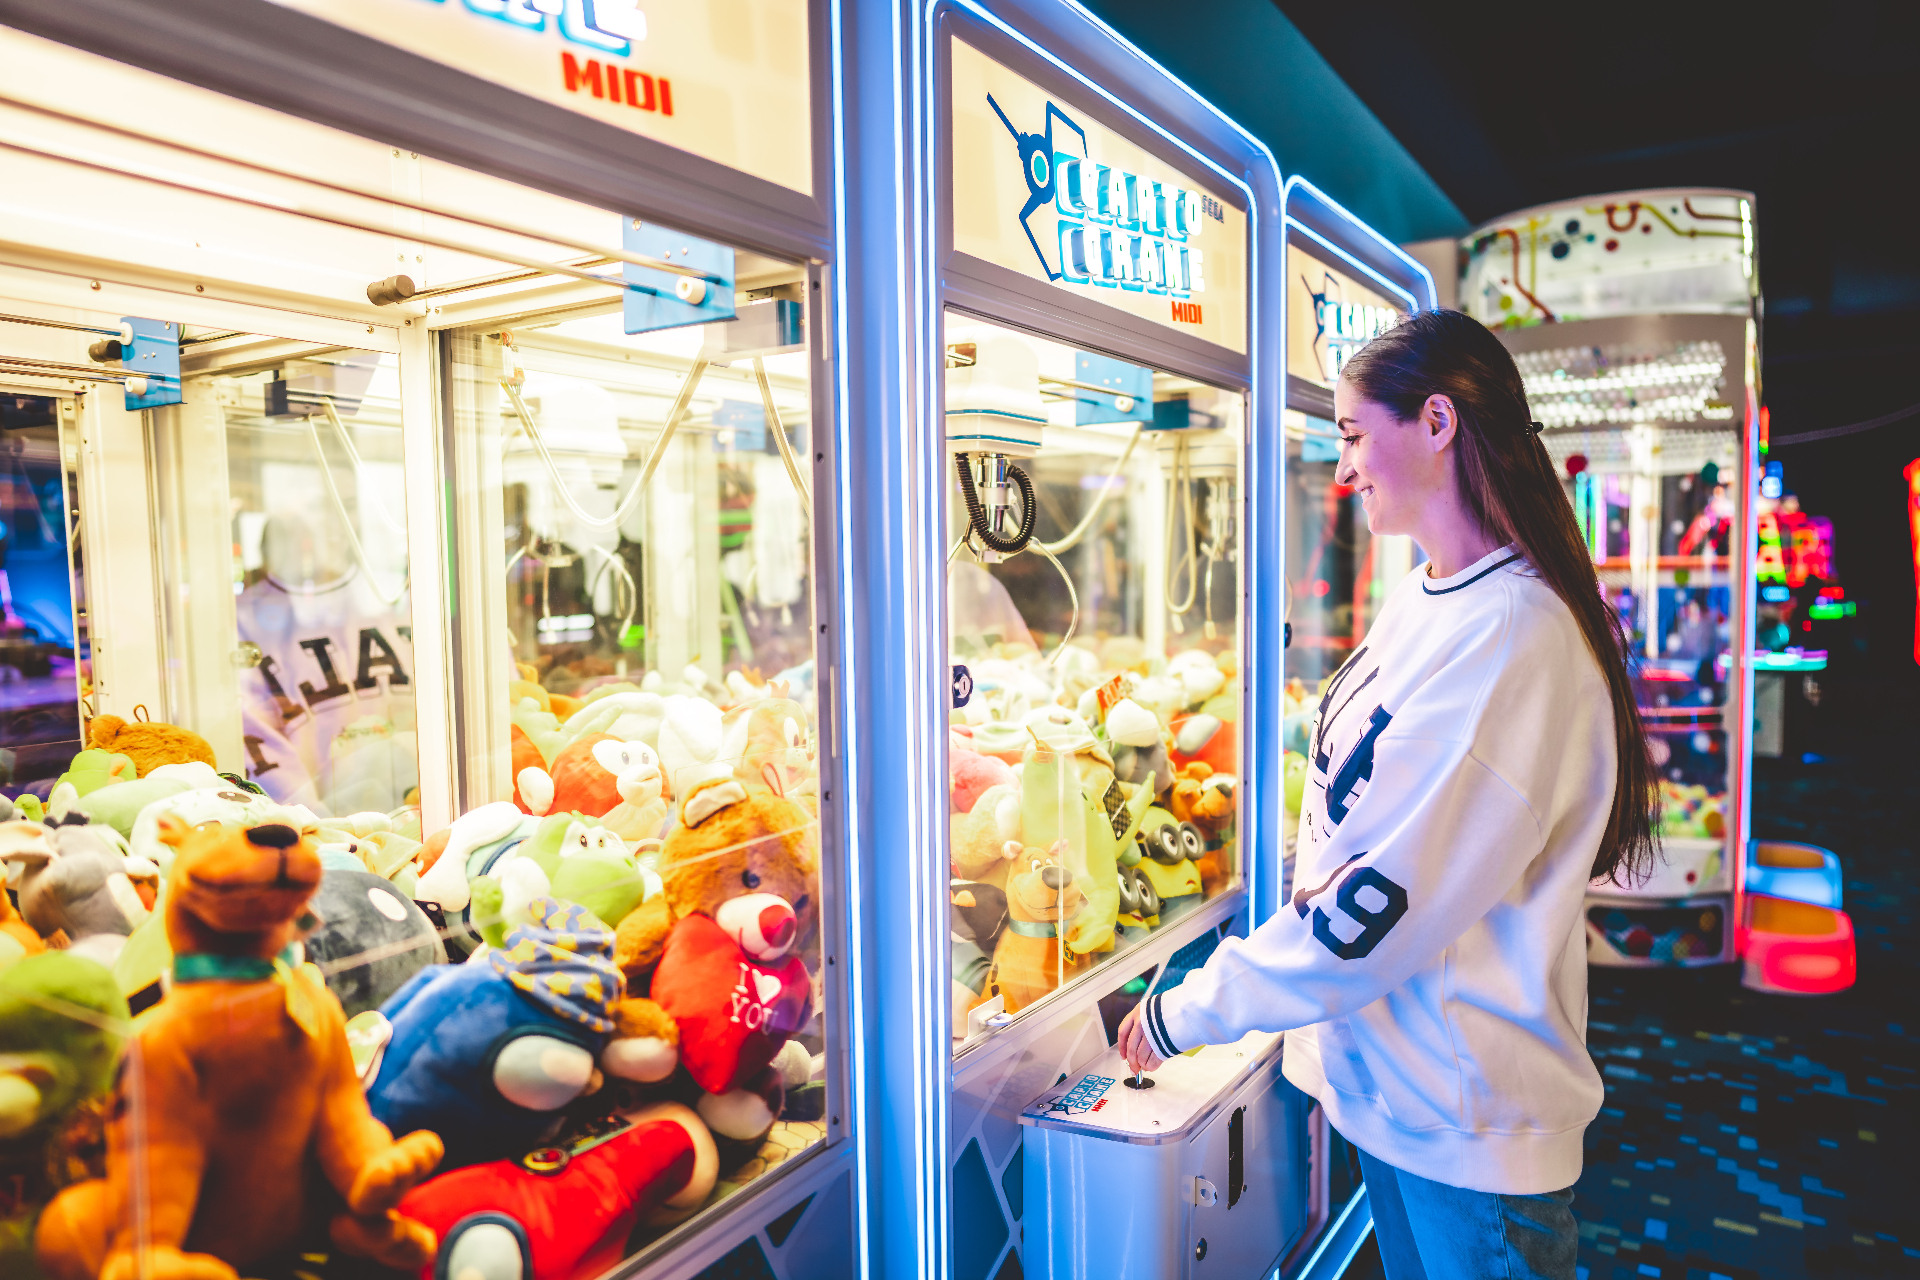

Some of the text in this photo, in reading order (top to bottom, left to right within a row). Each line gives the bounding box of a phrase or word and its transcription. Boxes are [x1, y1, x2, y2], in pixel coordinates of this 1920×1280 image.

[561, 51, 673, 117] MIDI
[1171, 301, 1203, 324] MIDI
[735, 962, 749, 994] I
[730, 992, 779, 1036] YOU
[1060, 1074, 1100, 1107] CAPTO
[1075, 1077, 1116, 1110] CRANE
